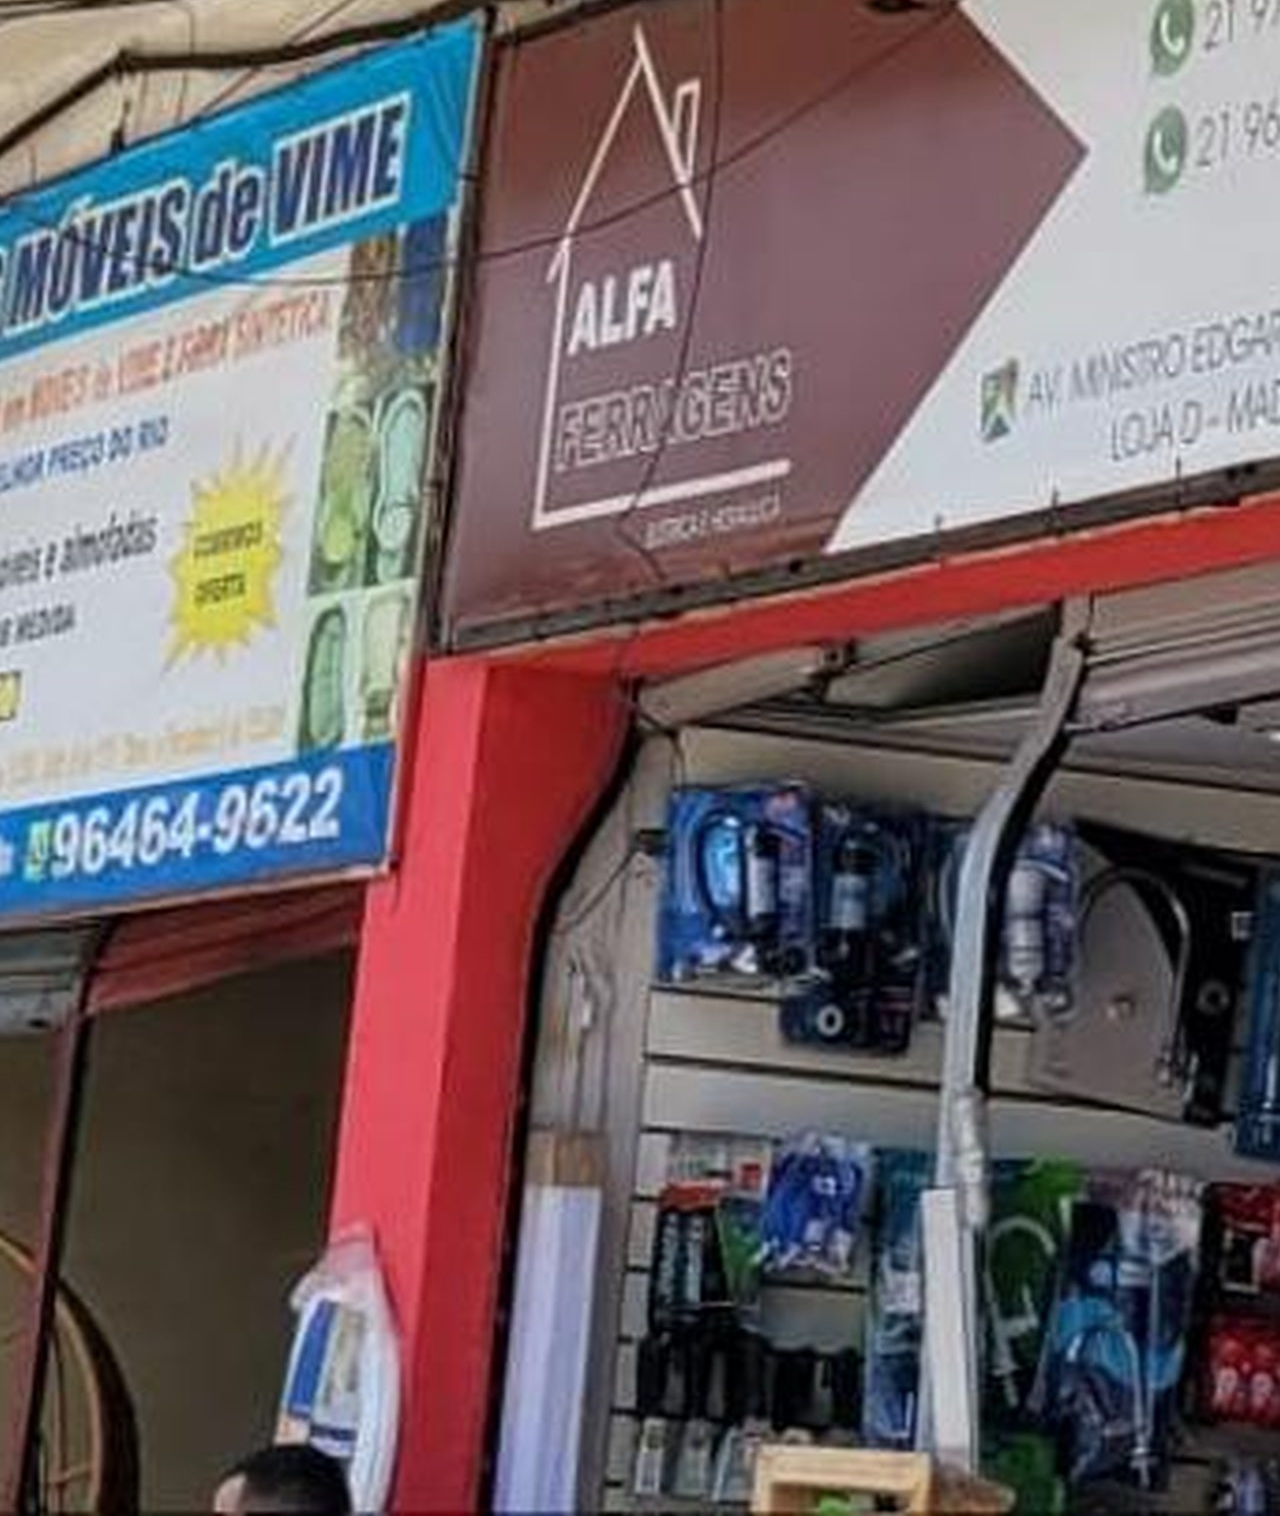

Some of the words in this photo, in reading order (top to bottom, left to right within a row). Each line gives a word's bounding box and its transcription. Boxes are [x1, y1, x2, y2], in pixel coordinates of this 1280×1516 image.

[192, 164, 264, 270] de
[272, 98, 408, 242] VIME
[1196, 109, 1230, 167] 21
[567, 258, 676, 356] ALFA
[1109, 401, 1175, 463] LOJA
[51, 766, 343, 879] 96464-9622
